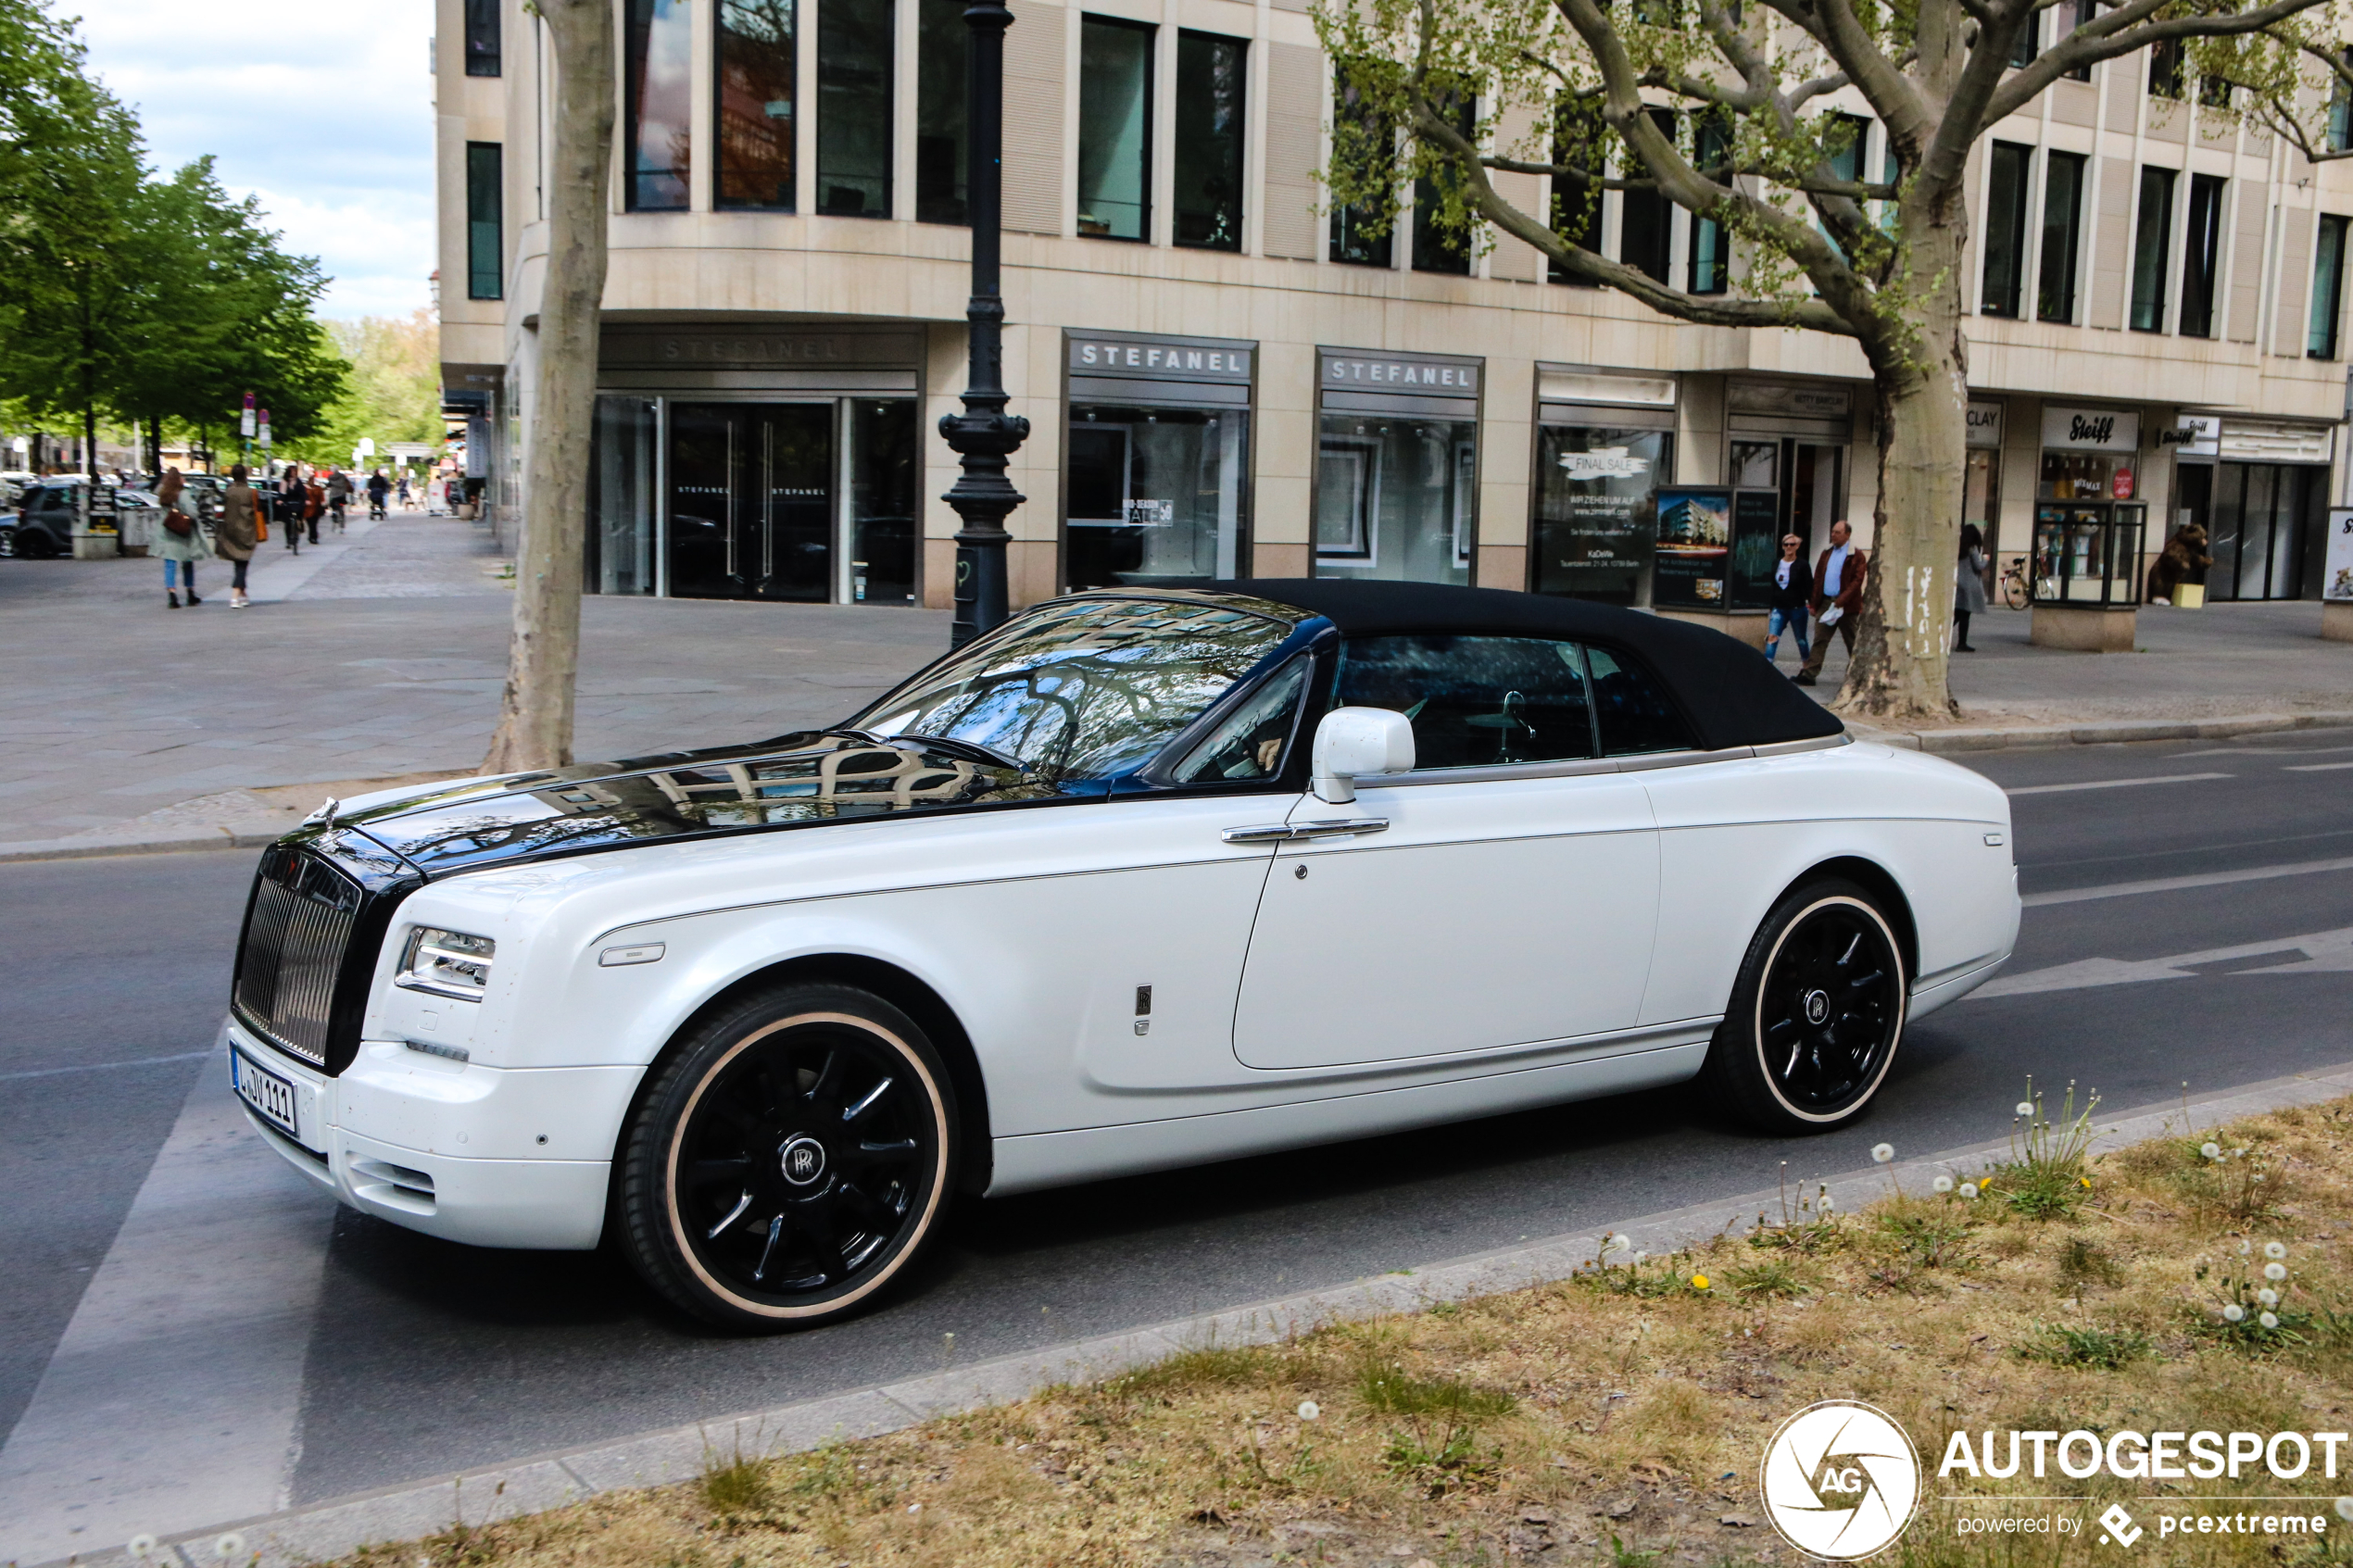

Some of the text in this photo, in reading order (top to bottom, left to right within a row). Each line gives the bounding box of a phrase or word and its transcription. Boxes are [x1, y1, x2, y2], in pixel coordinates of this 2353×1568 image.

[665, 339, 839, 360] STEFANEL
[1081, 345, 1240, 372] STEFANEL
[1331, 361, 1469, 387] STEFANEL
[2070, 414, 2115, 445] Steiff
[2162, 431, 2193, 445] Steiff
[1576, 458, 1632, 471] FINAL SALE
[1123, 509, 1158, 523] SALE
[1588, 549, 1614, 558] KaDeWe
[266, 1079, 291, 1123] 111
